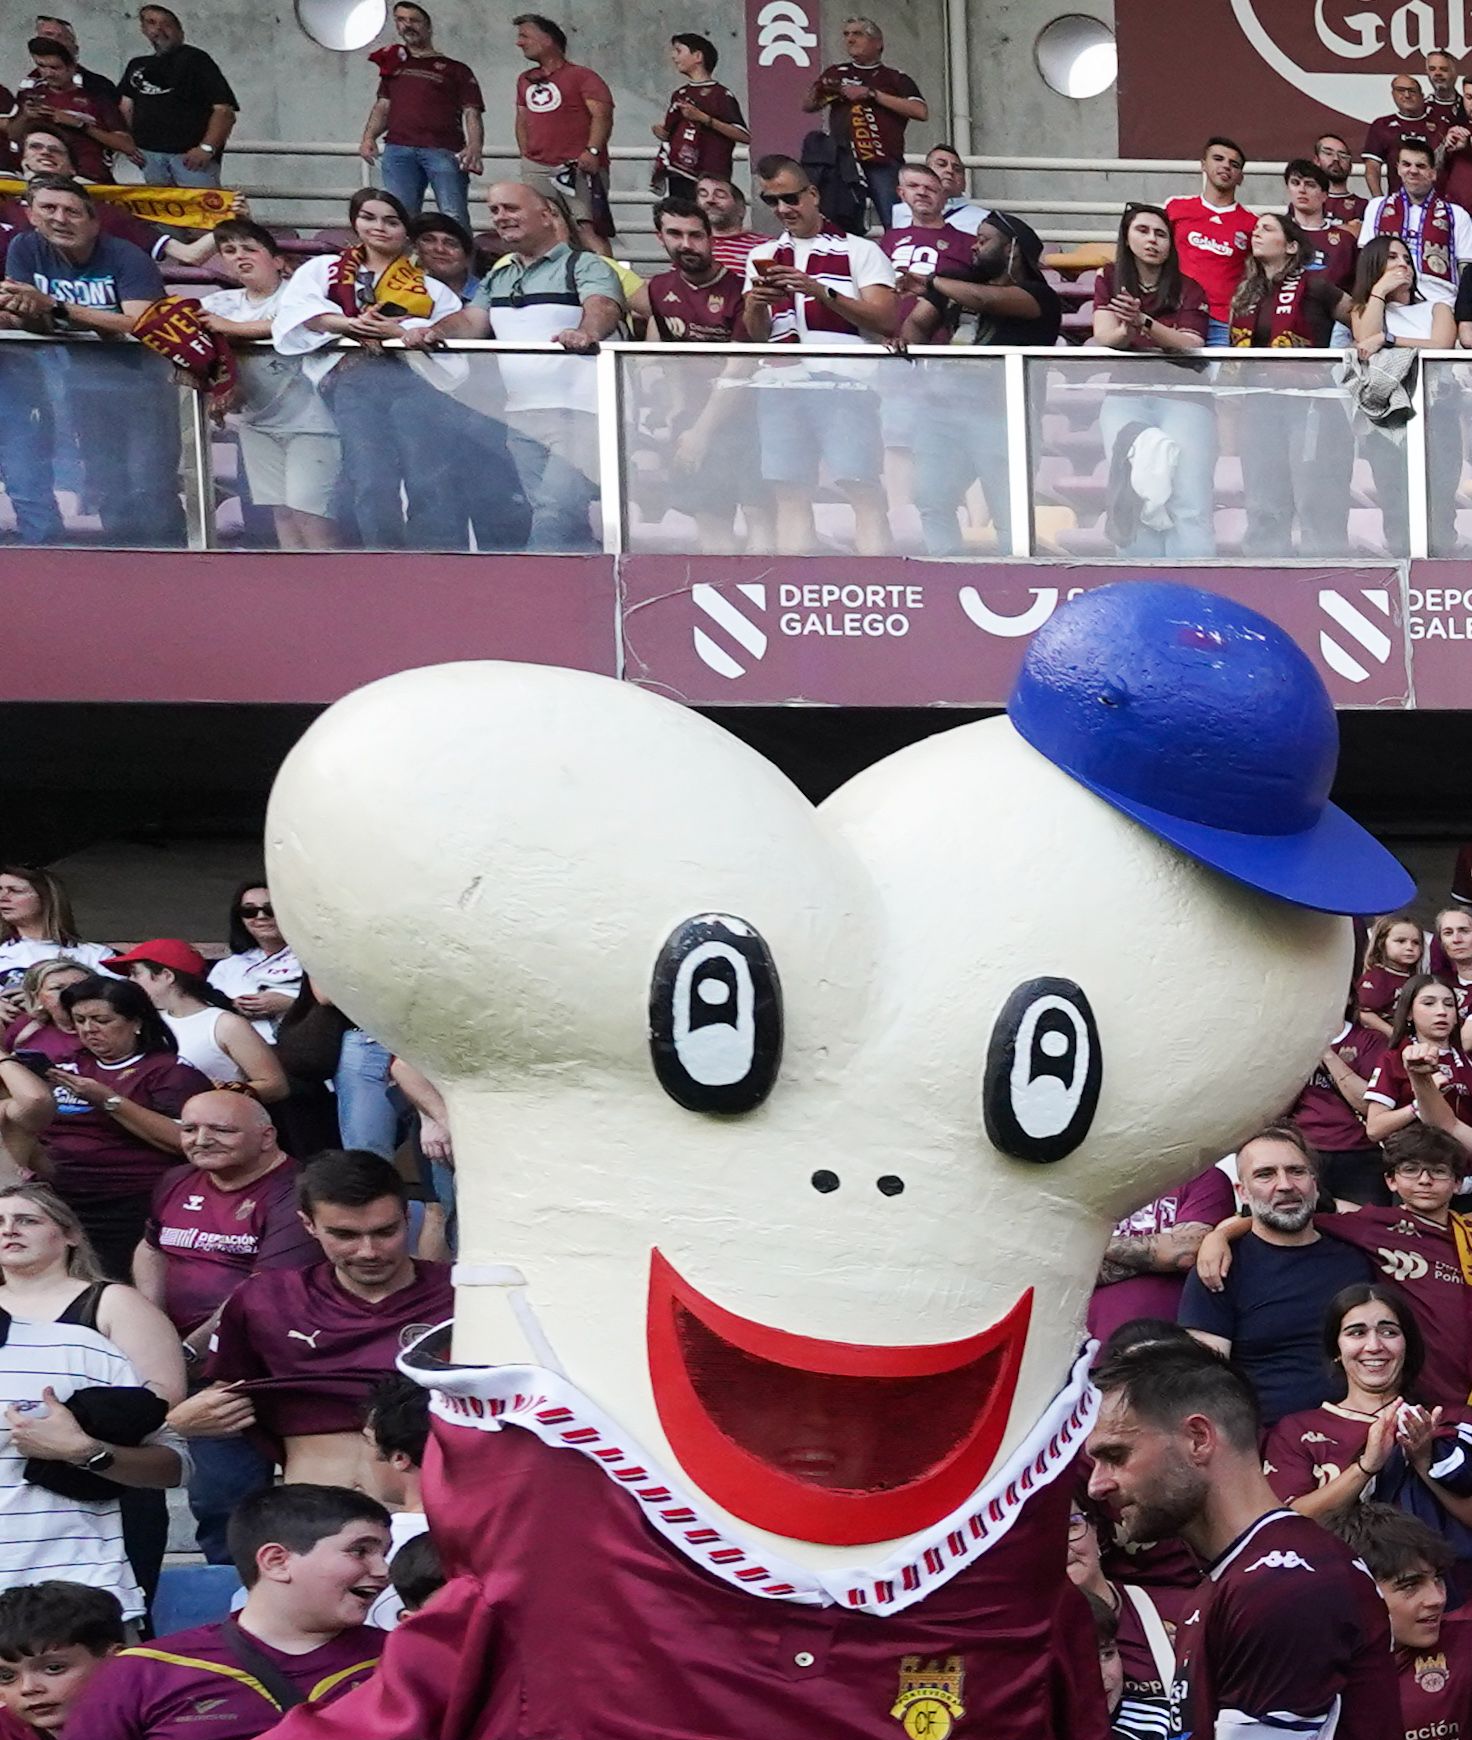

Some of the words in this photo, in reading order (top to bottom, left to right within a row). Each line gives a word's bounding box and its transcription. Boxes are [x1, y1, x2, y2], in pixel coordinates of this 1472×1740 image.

[1187, 230, 1235, 257] Carlsberg
[780, 584, 925, 610] DEPORTE
[778, 611, 911, 637] GALEGO
[915, 1710, 938, 1735] CF
